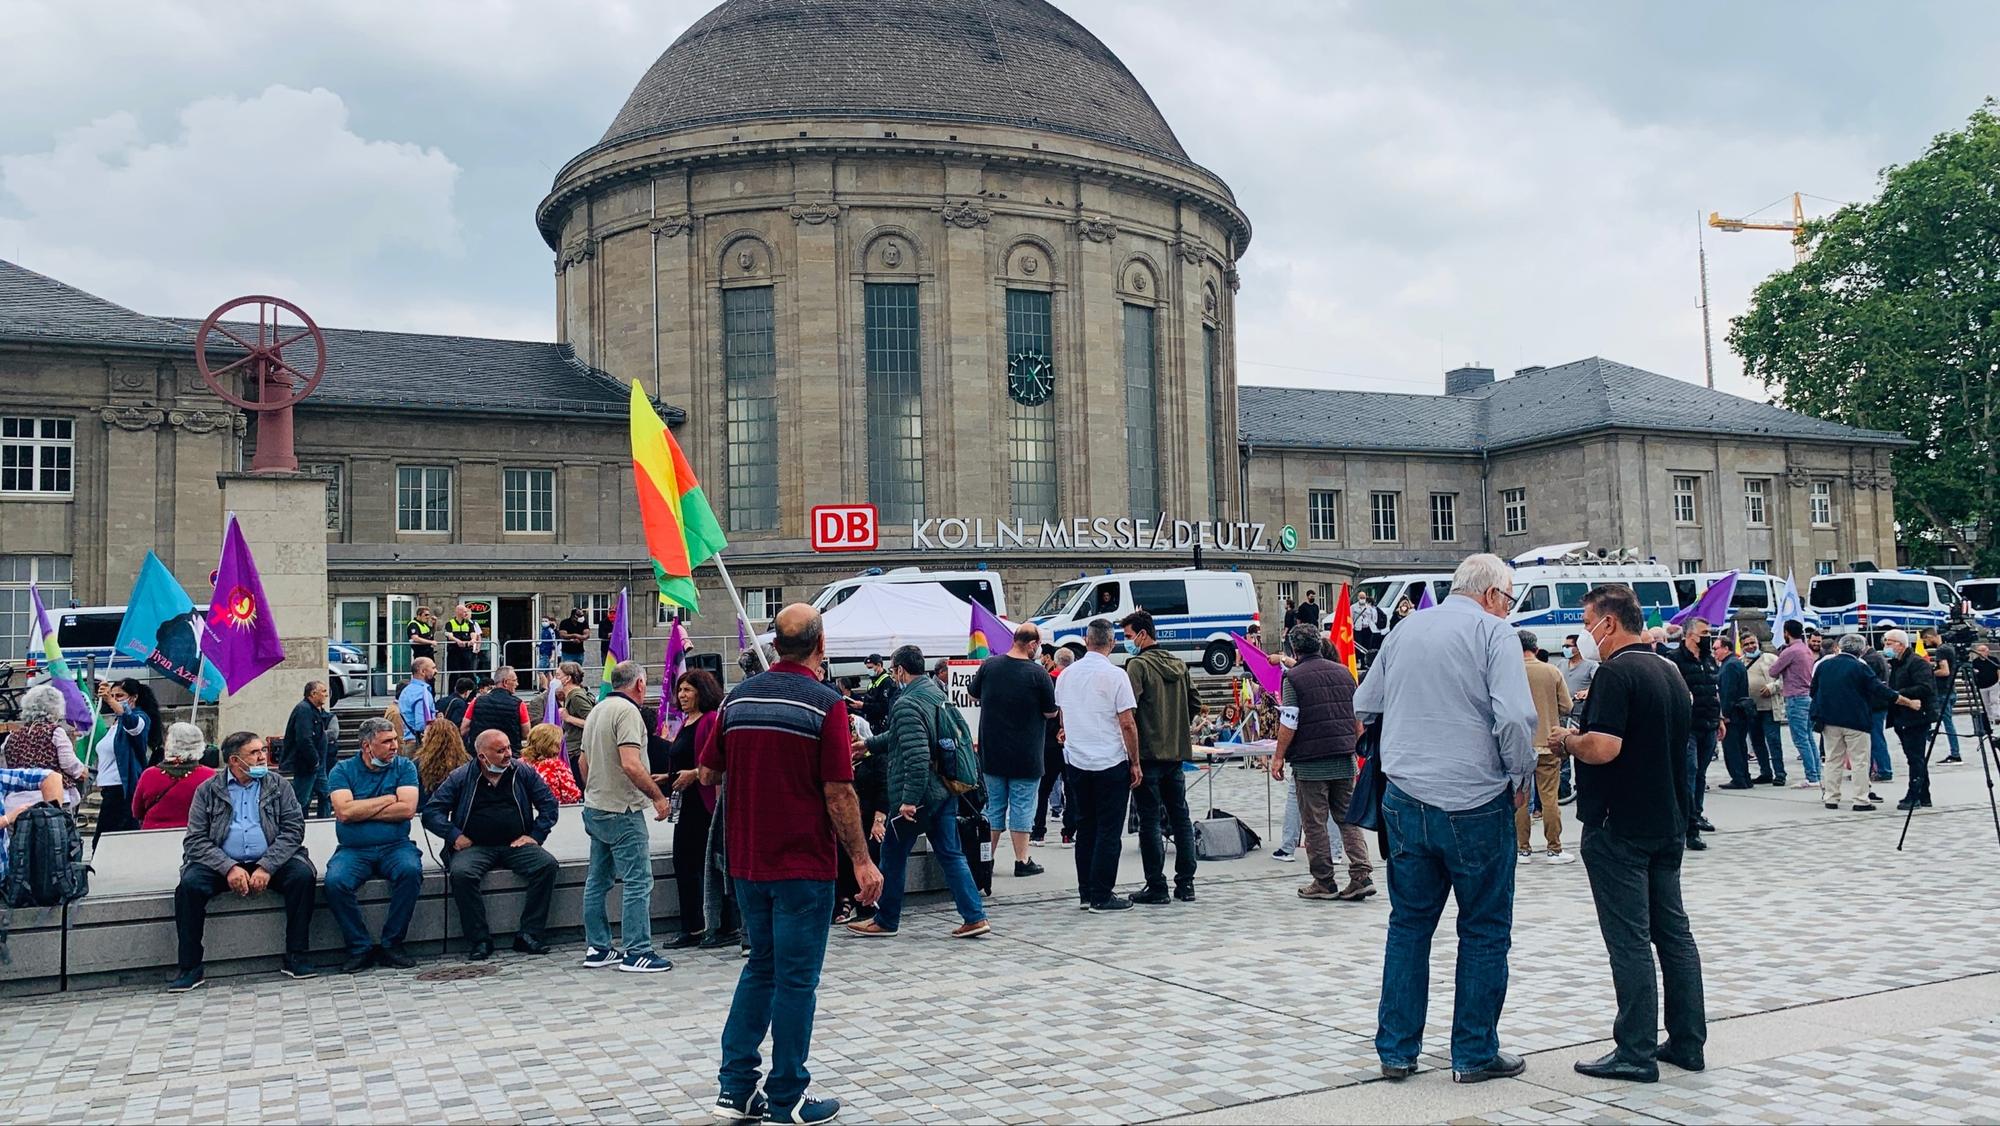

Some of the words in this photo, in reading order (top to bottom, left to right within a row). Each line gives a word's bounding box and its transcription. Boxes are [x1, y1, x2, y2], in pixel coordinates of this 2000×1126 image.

[820, 512, 870, 543] DB
[912, 517, 1023, 549] KÖLN
[466, 603, 488, 612] OPEN
[1563, 612, 1584, 621] POLIZ
[1157, 630, 1177, 639] LIZEI
[149, 648, 173, 671] Jiyan
